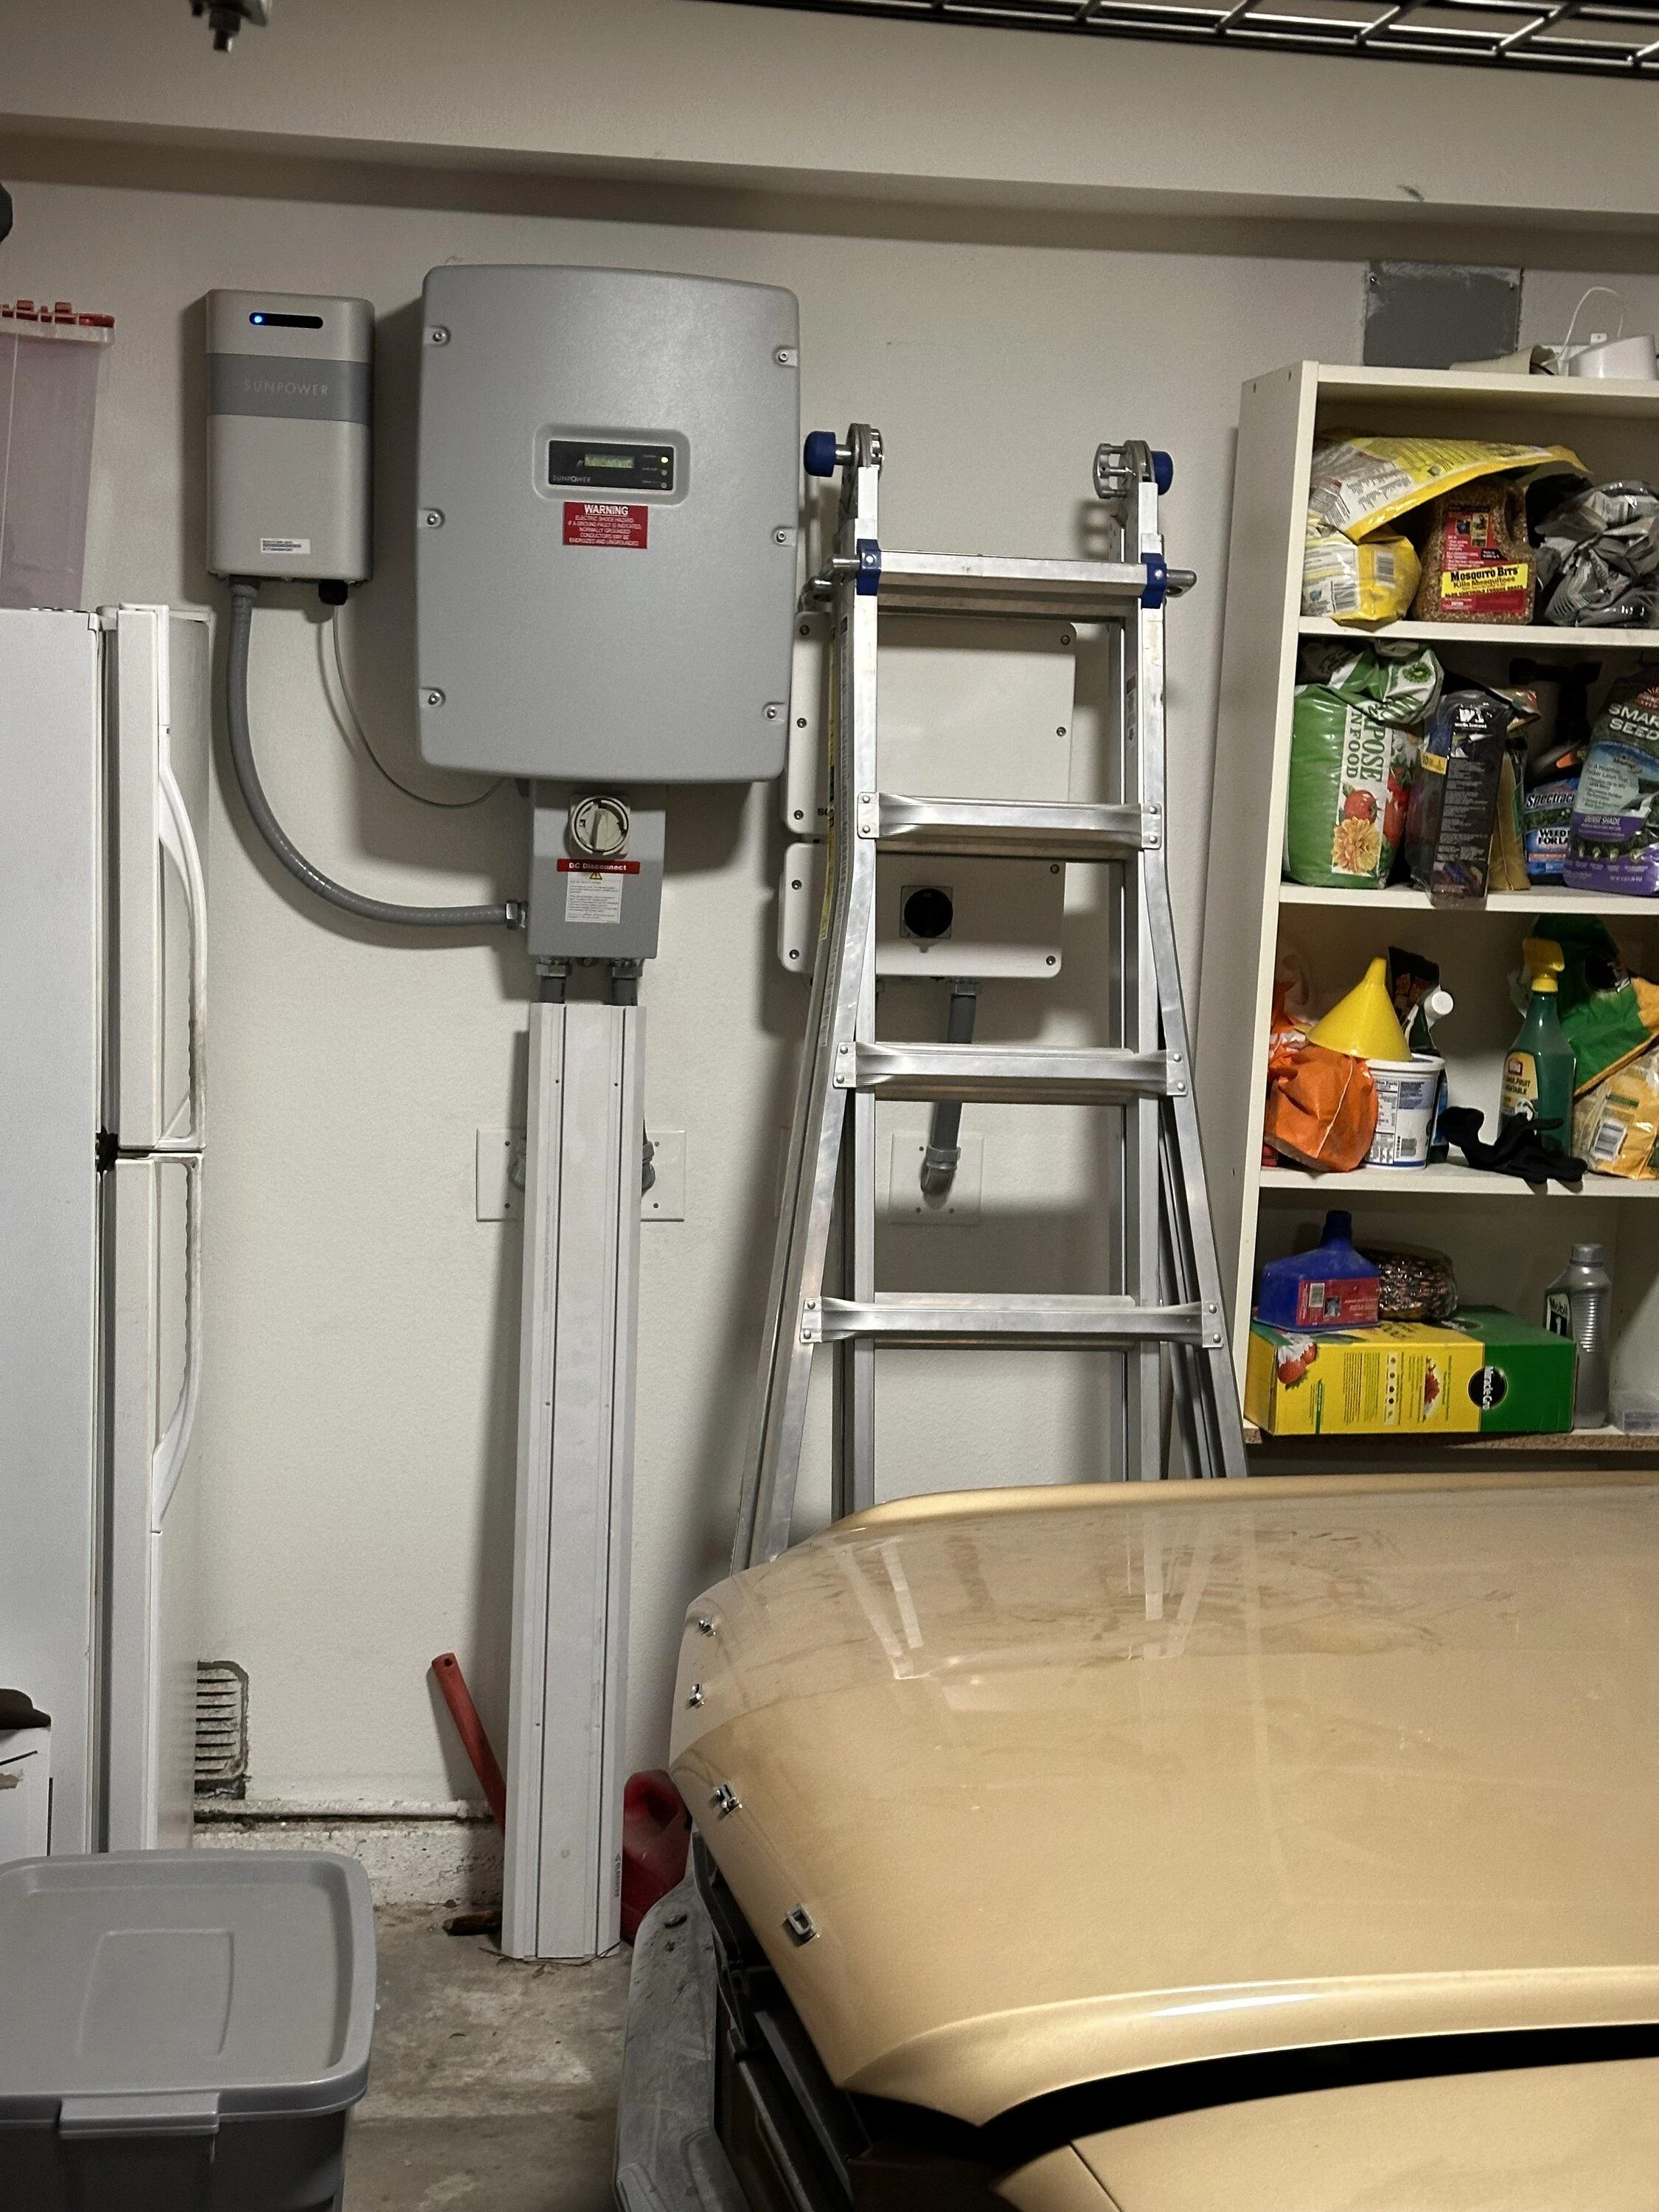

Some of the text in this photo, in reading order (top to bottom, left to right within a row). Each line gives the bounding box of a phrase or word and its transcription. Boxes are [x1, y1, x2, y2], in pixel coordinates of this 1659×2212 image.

[244, 380, 328, 396] SUNPOWER
[584, 504, 629, 515] WARNING
[1450, 566, 1519, 582] MOSQUITO BITS
[1453, 580, 1470, 588] Kills
[1609, 717, 1659, 741] SEED
[1346, 728, 1362, 779] FOOD
[582, 863, 627, 871] Disconnect
[1549, 1297, 1568, 1316] Mobil
